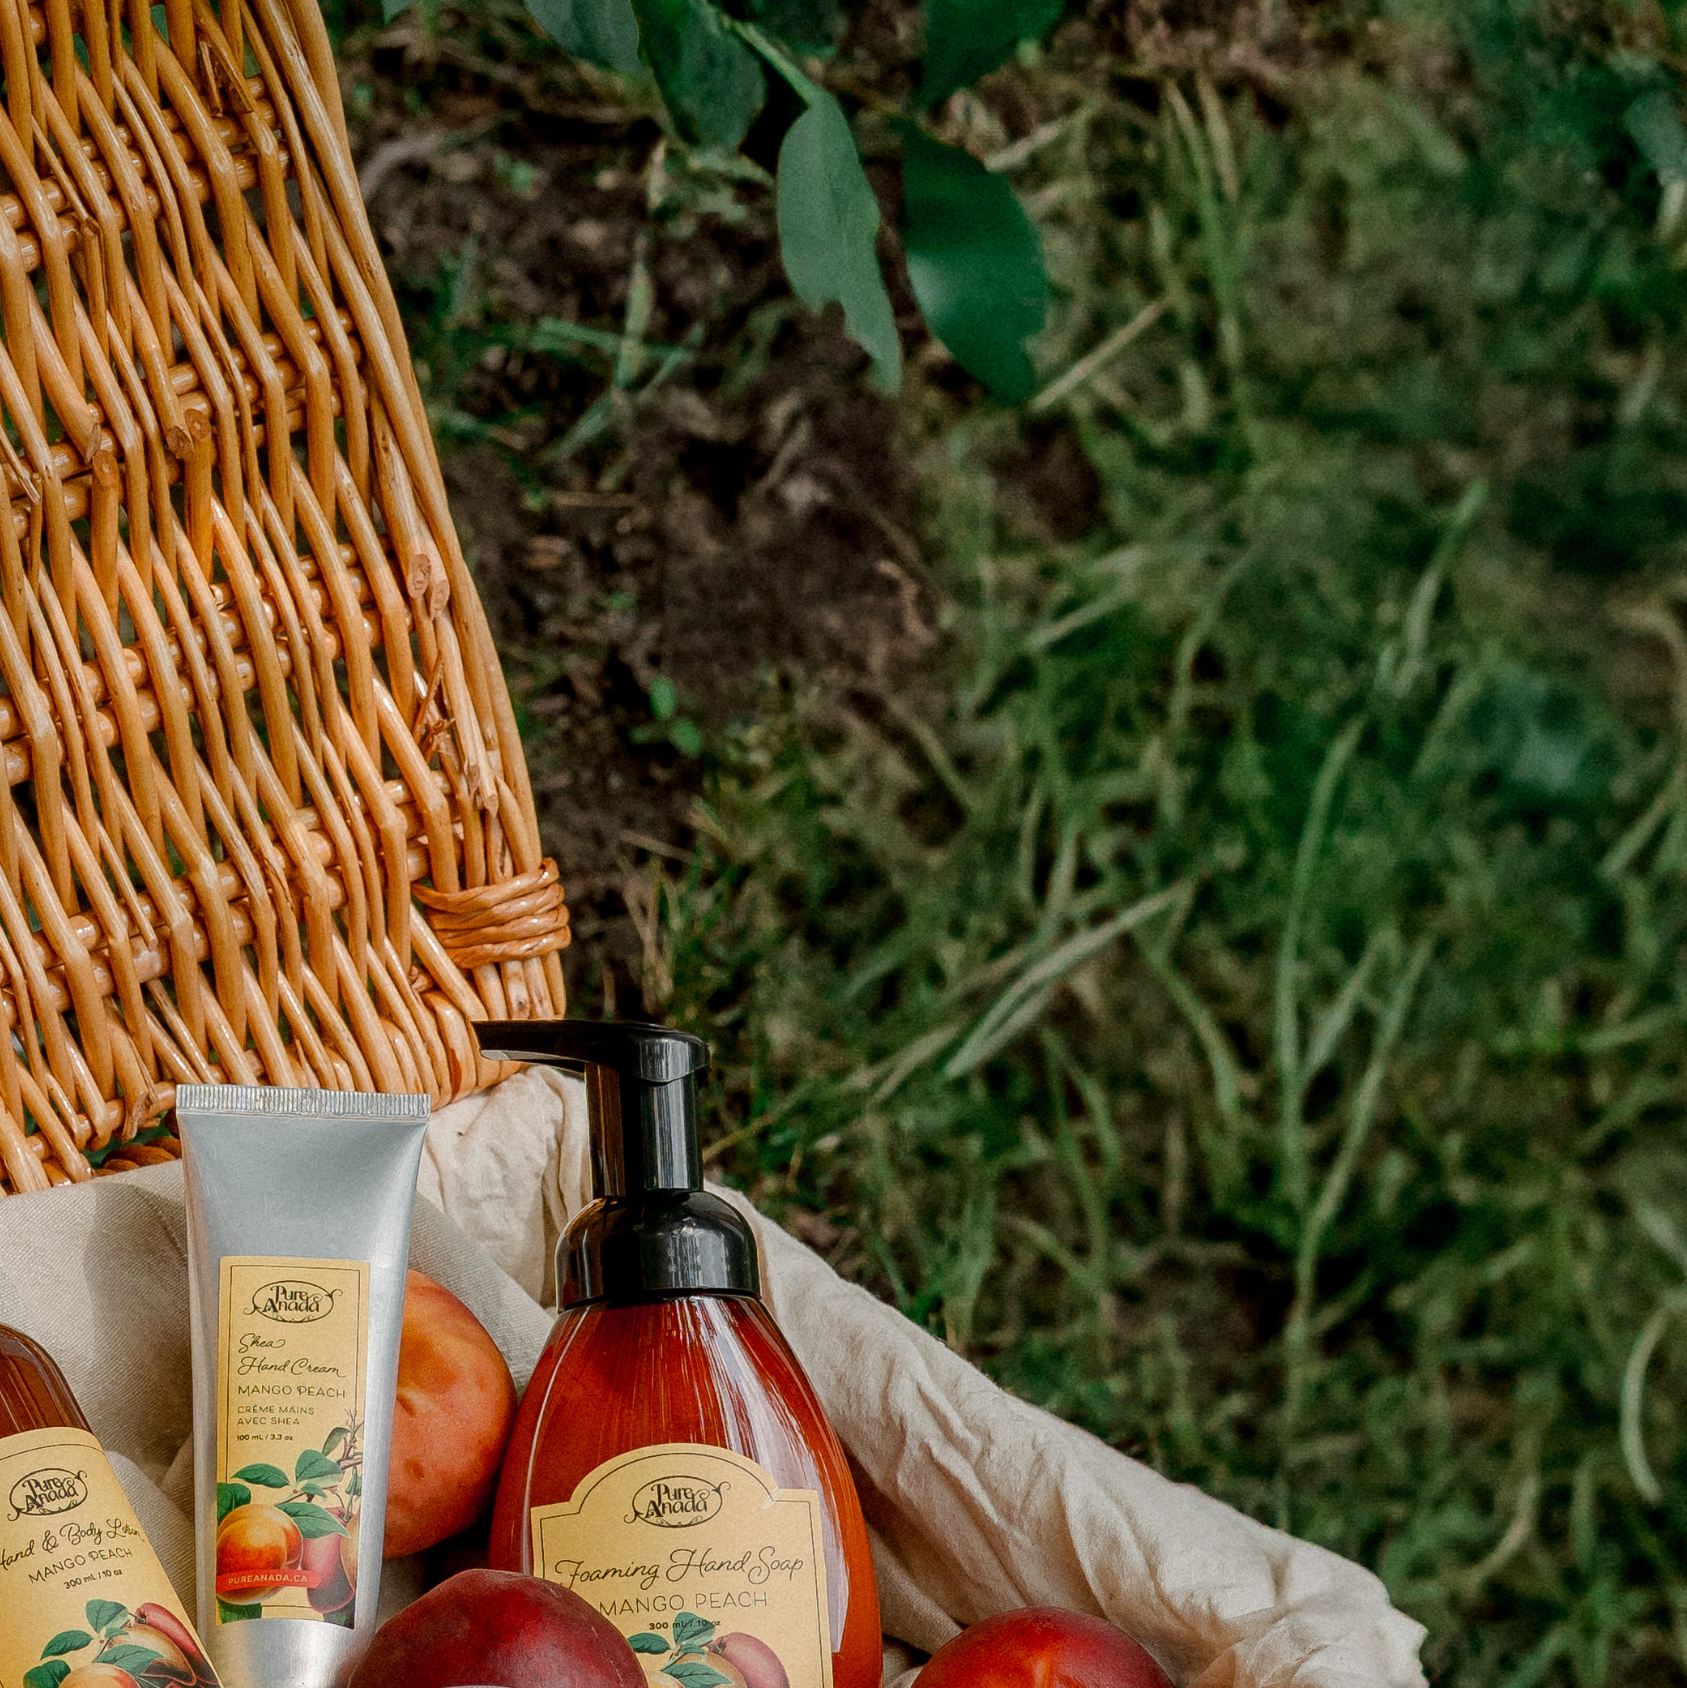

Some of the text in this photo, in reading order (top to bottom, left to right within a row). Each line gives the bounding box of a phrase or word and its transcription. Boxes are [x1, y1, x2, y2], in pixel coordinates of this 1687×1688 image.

[262, 1294, 322, 1313] Anada
[270, 1285, 308, 1304] Pure
[238, 1333, 286, 1353] Shea
[237, 1356, 346, 1378] Hand Cream
[238, 1385, 346, 1399] MANGO PEACH
[278, 1405, 315, 1415] MAINS
[237, 1416, 300, 1426] AVEC SHEA
[22, 1477, 63, 1498] Pure
[24, 1479, 79, 1512] Anada
[651, 1483, 694, 1507] Pure
[644, 1491, 709, 1518] Anada
[42, 1530, 58, 1553] &
[60, 1522, 102, 1545] Body
[106, 1518, 145, 1541] Lotion
[28, 1548, 133, 1584] MANGO PEACH
[555, 1546, 804, 1590] Foaming Hand Soap
[64, 1578, 82, 1589] 300
[83, 1572, 96, 1583] mL
[102, 1570, 112, 1578] 10
[228, 1574, 308, 1585] PUREANADA.CA
[600, 1591, 768, 1616] MANGO PEACH
[649, 1622, 669, 1630] 300
[672, 1620, 688, 1629] mL
[697, 1619, 708, 1627] 10
